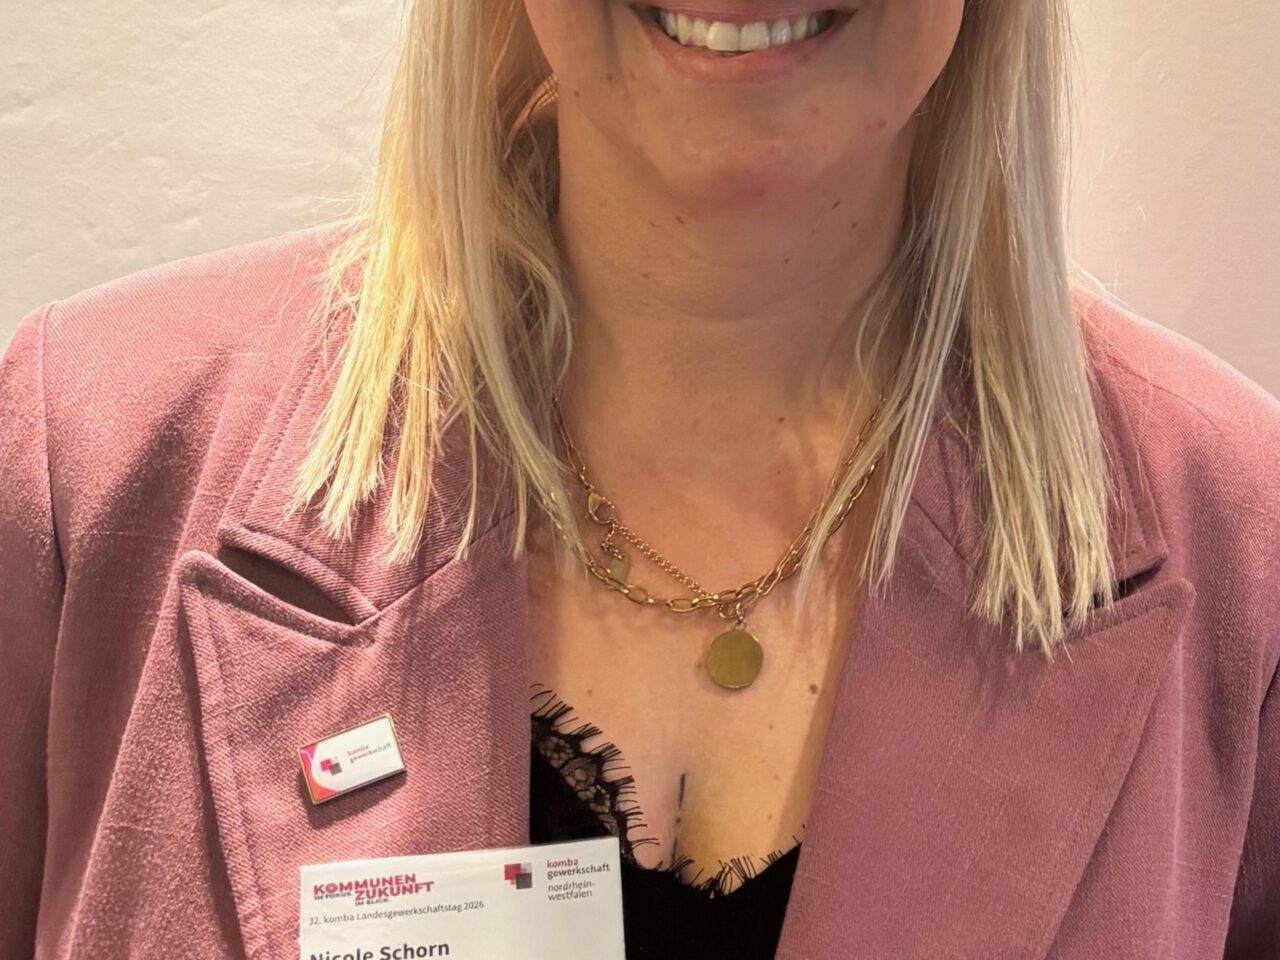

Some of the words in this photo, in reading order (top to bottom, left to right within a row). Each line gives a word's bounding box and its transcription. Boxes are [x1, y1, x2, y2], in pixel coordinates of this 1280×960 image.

[547, 858, 578, 868] komba
[547, 863, 610, 880] gewerkschaft
[314, 873, 416, 895] KOMMUNEN
[354, 881, 434, 901] ZUKUNFT
[548, 880, 596, 892] nordrhein-
[548, 890, 592, 901] westfalen
[309, 916, 321, 926] 32.
[323, 914, 355, 924] komba
[356, 901, 462, 921] Landesgewerkschaftstag
[463, 900, 485, 911] 2026
[379, 943, 450, 960] Schorn
